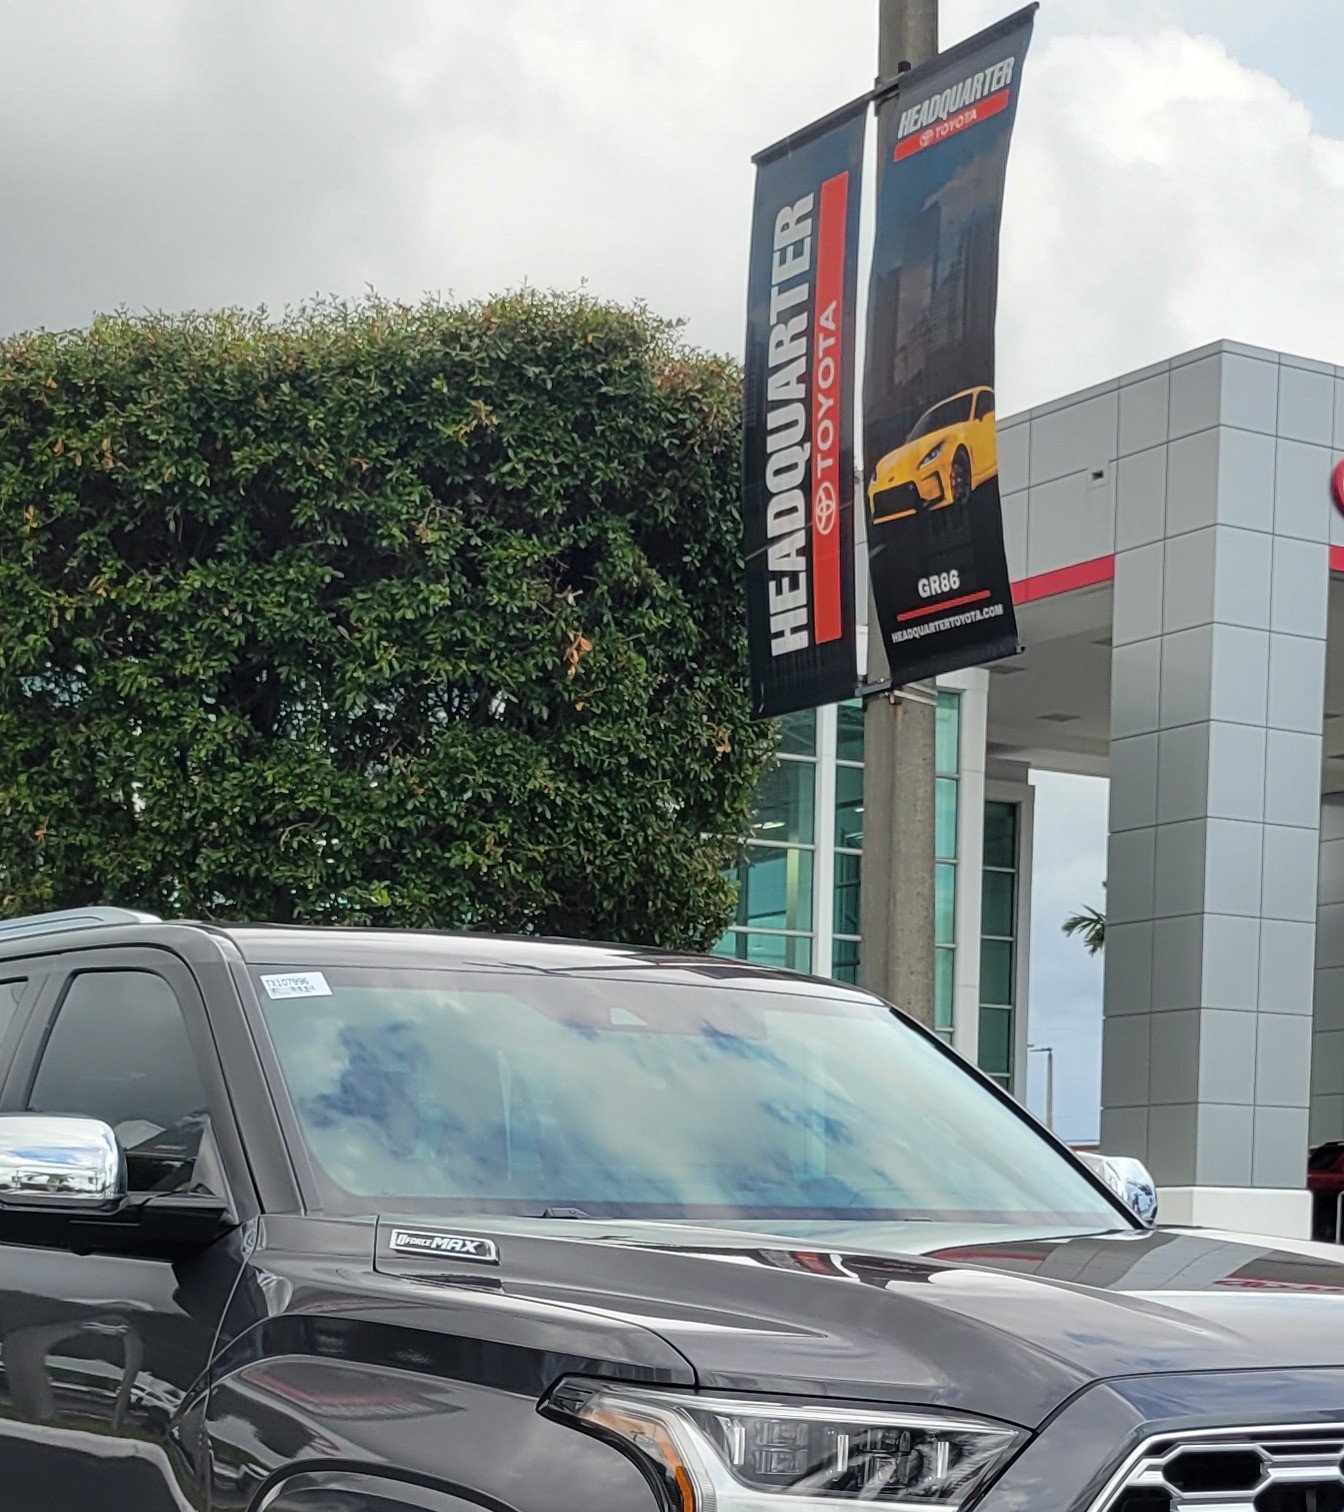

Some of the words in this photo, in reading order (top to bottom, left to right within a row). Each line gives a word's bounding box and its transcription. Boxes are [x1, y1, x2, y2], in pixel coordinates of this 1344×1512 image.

[898, 56, 1015, 139] HEADQUARTER
[936, 109, 977, 139] TOYOTA
[816, 300, 837, 480] TOYOTA
[765, 193, 815, 657] HEADQUARTER
[917, 569, 960, 598] GR86
[891, 603, 1004, 643] HEADQUARTERTOYOTA.COM
